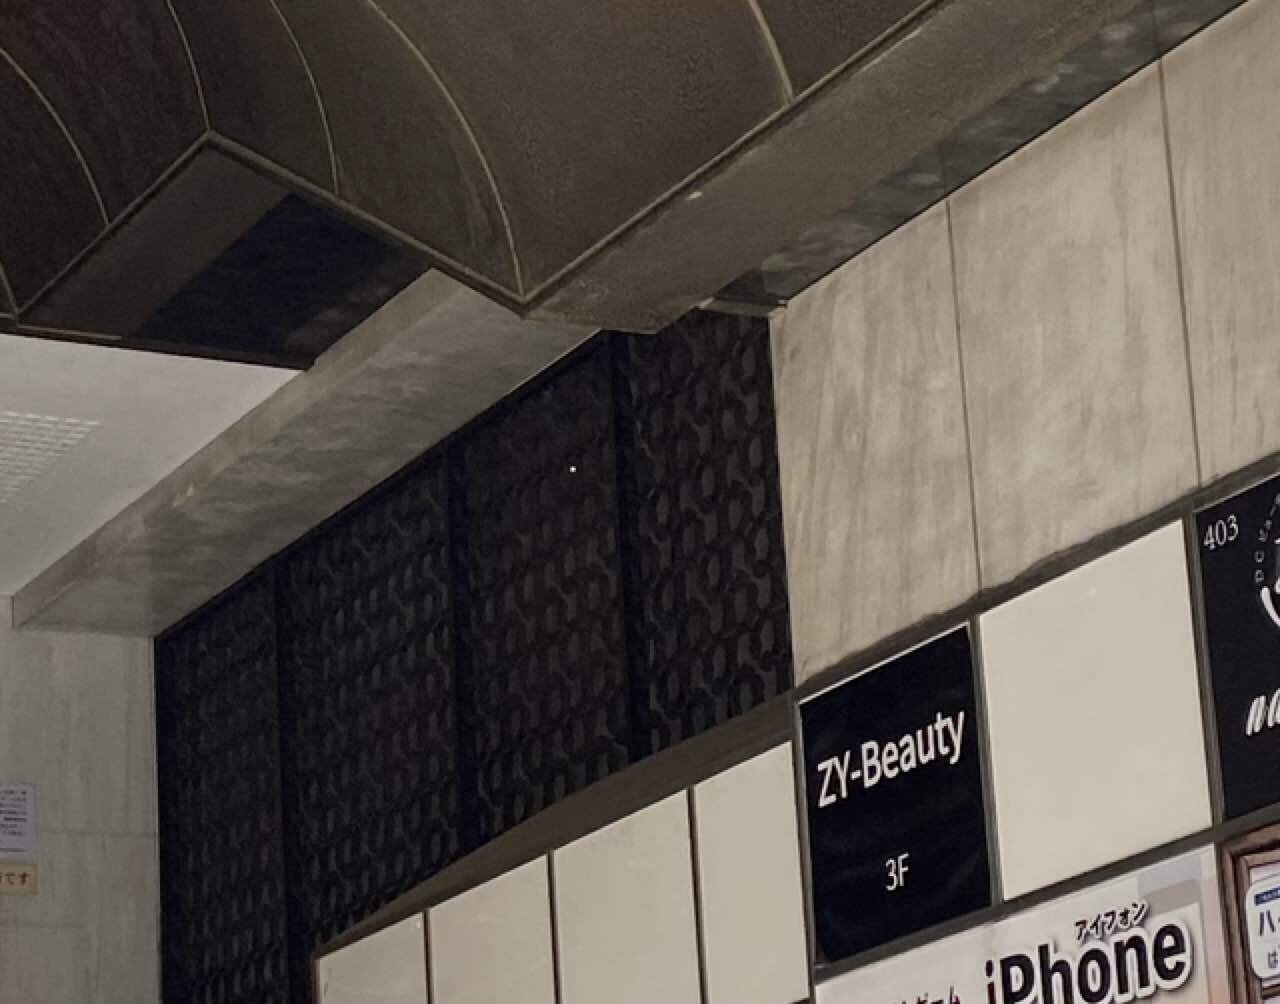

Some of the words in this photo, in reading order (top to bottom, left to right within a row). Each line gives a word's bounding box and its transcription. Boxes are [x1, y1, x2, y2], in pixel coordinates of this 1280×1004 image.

[1203, 514, 1239, 550] 403
[817, 710, 965, 808] ZY-Beauty
[885, 853, 910, 891] 3F
[1074, 902, 1148, 940] アイフォン
